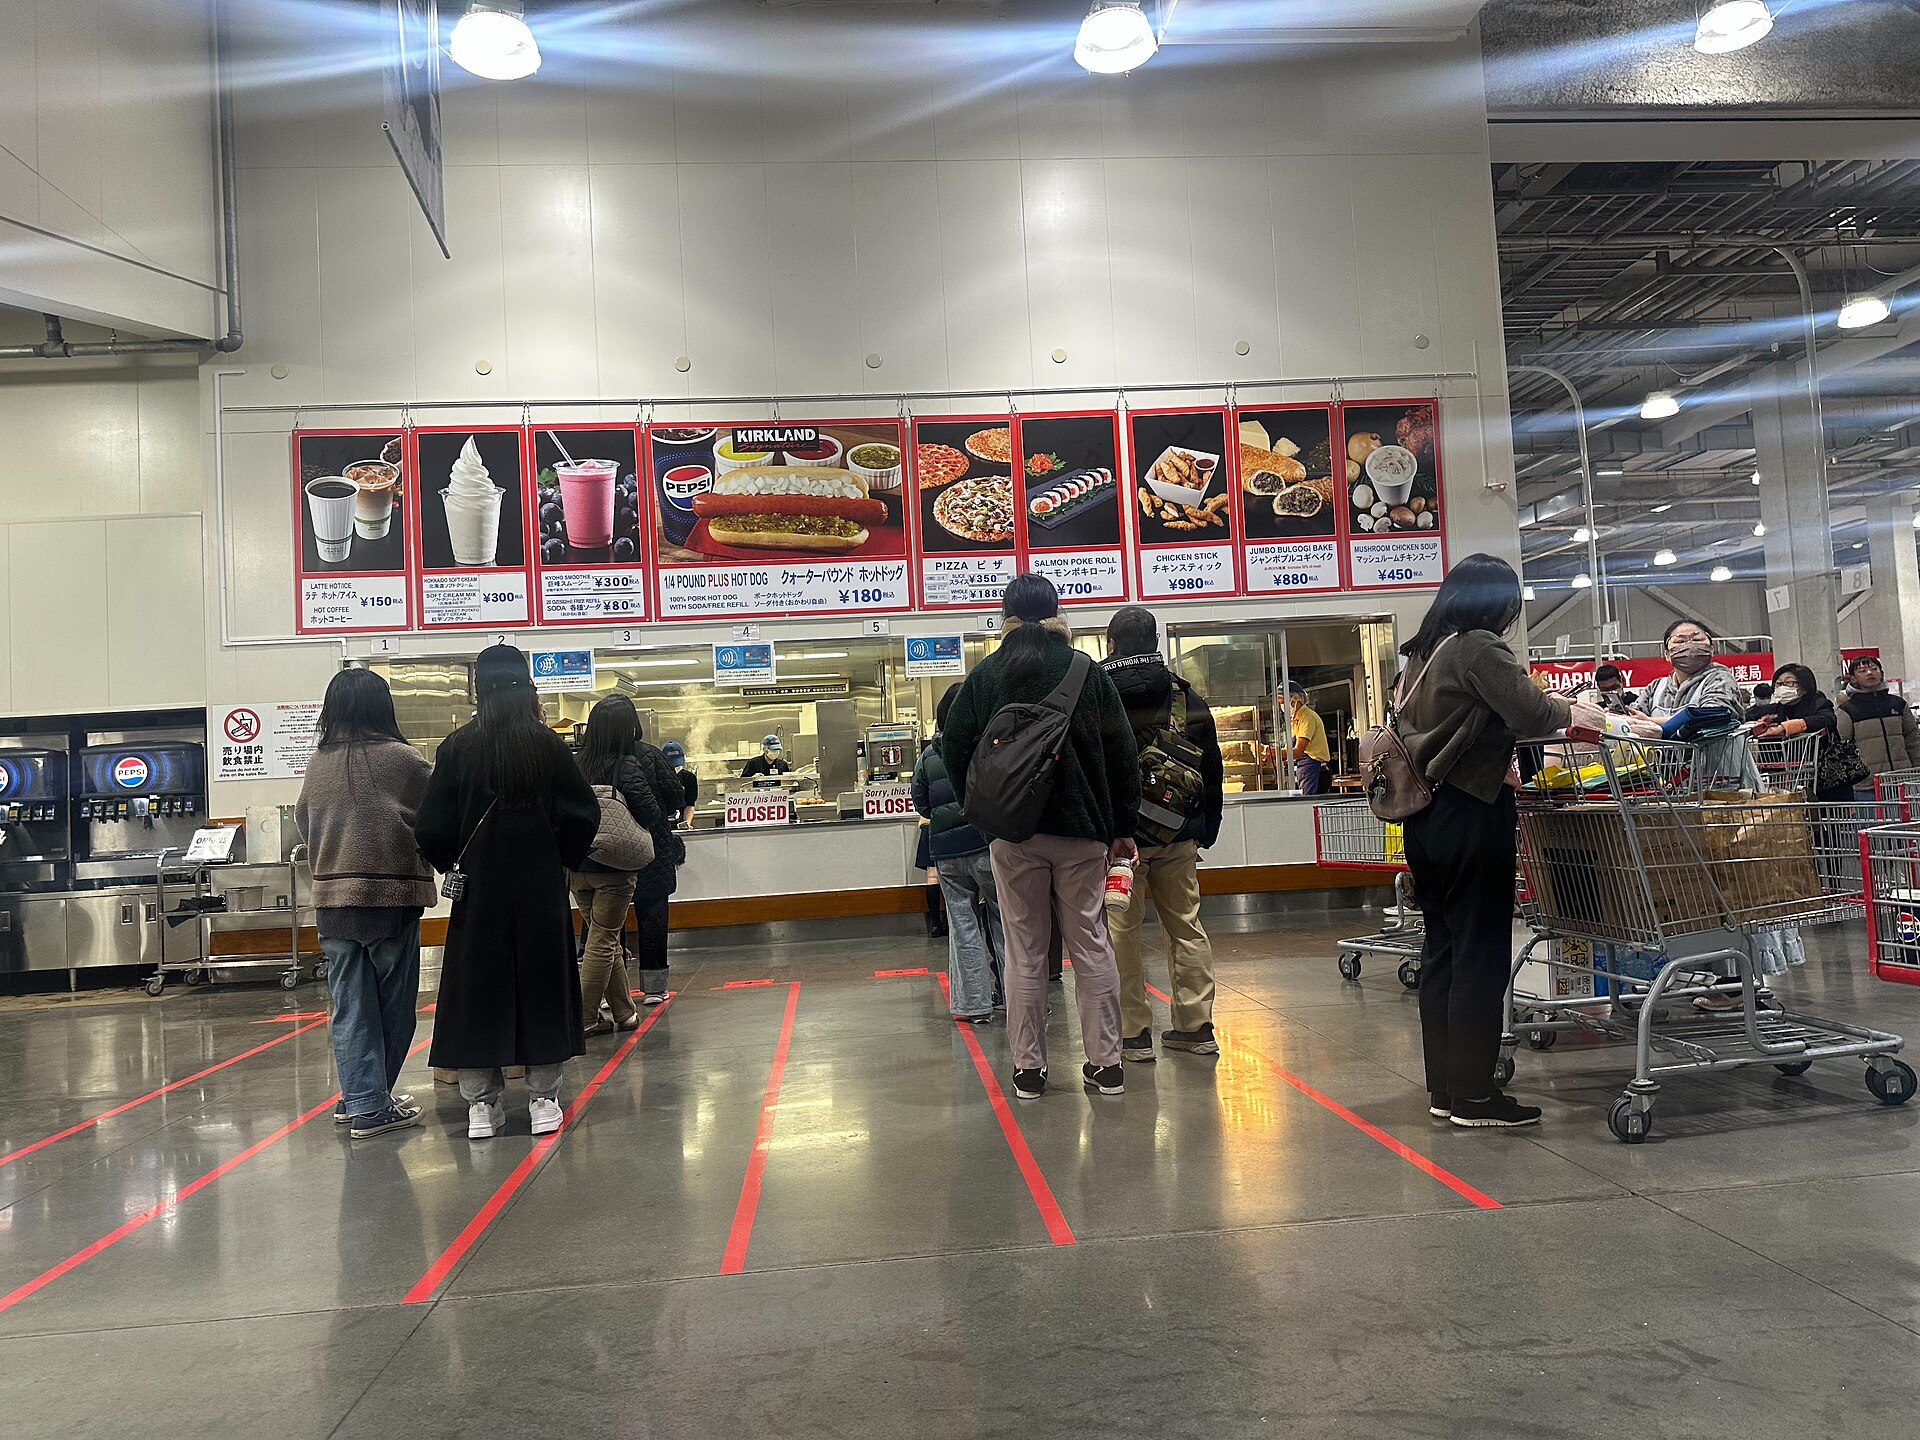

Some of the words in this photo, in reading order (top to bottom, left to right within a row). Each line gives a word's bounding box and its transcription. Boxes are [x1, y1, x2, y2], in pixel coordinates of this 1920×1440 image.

[736, 428, 816, 442] KIRKLAND
[738, 442, 816, 452] Signature
[665, 477, 711, 493] PEPSI
[1250, 547, 1275, 555] JUMBO
[1278, 545, 1311, 553] BULGOGI
[1313, 544, 1333, 552] BAKE
[1034, 558, 1068, 567] SALMON
[1156, 554, 1192, 562] CHICKEN
[1194, 552, 1218, 560] STICK
[1250, 553, 1333, 564] ジャンボブルコギベイク
[1356, 552, 1438, 564] マッシュルームチキンスープ
[935, 562, 968, 570] PIZZA
[1152, 562, 1222, 574] チキンスティック
[781, 567, 854, 585] クォーターパウンド
[859, 564, 904, 582] ホットドッグ
[1036, 567, 1116, 577] サーモンポキロール
[1378, 568, 1412, 580] ¥450
[594, 577, 628, 587] ¥300
[664, 575, 675, 589] 1/4
[677, 574, 706, 588] POUND
[708, 573, 729, 587] PLUS
[731, 572, 748, 586] HOT
[750, 572, 768, 586] DOG
[969, 574, 997, 583] ¥350
[1169, 578, 1204, 590] ¥980
[1273, 573, 1308, 586] ¥880
[1057, 582, 1092, 595] ¥700
[305, 592, 318, 600] ラテ
[322, 591, 358, 600] ホット/アイス
[483, 592, 514, 602] ¥300
[838, 589, 881, 604] ¥180
[360, 596, 392, 607] ¥150
[604, 600, 628, 611] ¥80
[310, 615, 353, 624] ホットコーヒー
[987, 618, 994, 628] 6
[743, 626, 750, 636] 4
[873, 622, 880, 632] 5
[498, 635, 505, 645] 2
[623, 630, 630, 641] 3
[382, 640, 389, 650] 1
[1117, 658, 1139, 667] WORLD
[222, 745, 263, 755] 売り場内
[222, 755, 263, 766] 飲食禁止
[865, 789, 889, 797] Sorry,
[891, 788, 905, 796] this
[728, 796, 752, 805] Sorry,
[754, 795, 768, 803] this
[770, 794, 787, 802] lane
[866, 798, 914, 815] CLOSE
[727, 806, 786, 823] CLOSED
